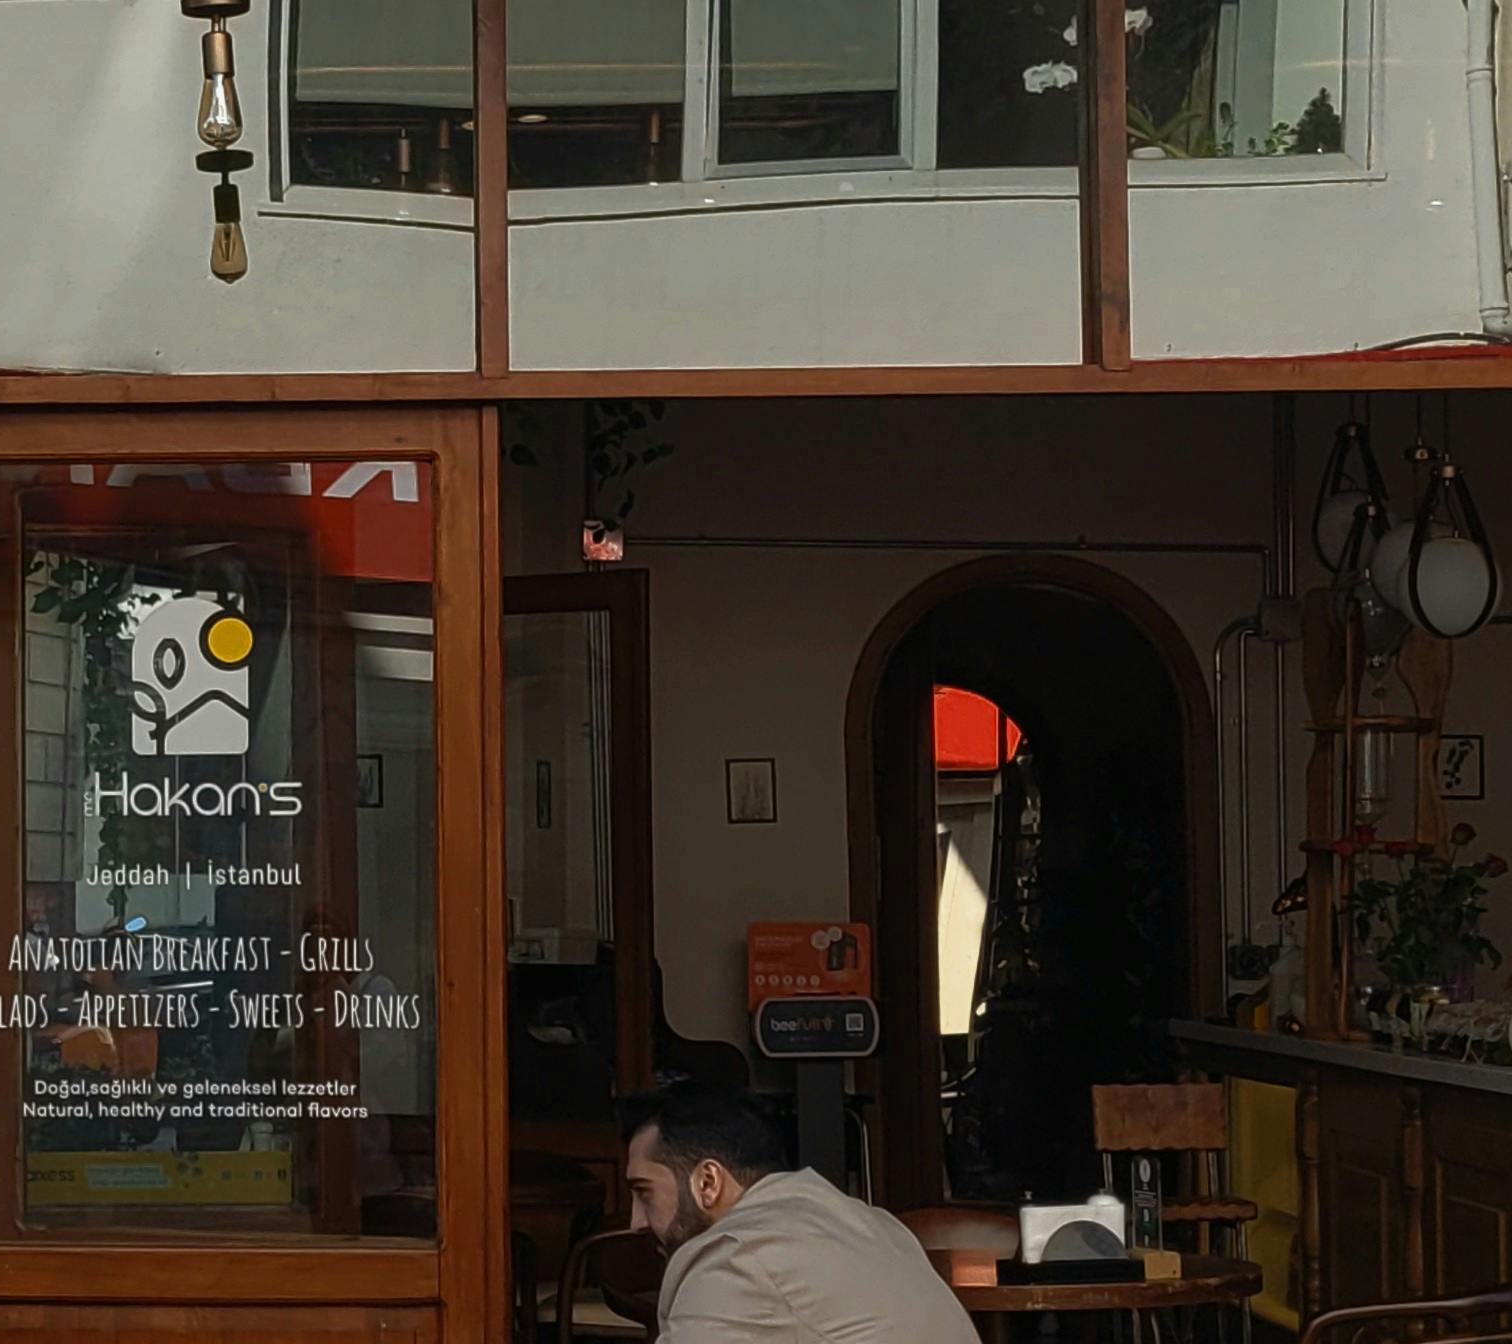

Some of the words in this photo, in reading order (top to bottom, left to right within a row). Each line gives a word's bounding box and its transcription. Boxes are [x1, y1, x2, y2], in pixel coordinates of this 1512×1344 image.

[94, 771, 303, 816] Hakan's
[86, 863, 169, 886] Jeddah
[8, 934, 143, 972] ANATOLIAN
[152, 933, 271, 972] BREAKFAST
[300, 932, 374, 972] GRILLS
[78, 990, 199, 1029] APPETIZERS
[229, 989, 304, 1029] SWEETS
[334, 990, 421, 1030] DRINKS
[157, 1083, 178, 1095] ve
[183, 1079, 277, 1099] geleneksel
[282, 1079, 357, 1096] lezzetler
[23, 1102, 93, 1120] Natural,
[99, 1102, 165, 1122] healthy
[170, 1102, 204, 1118] and
[209, 1102, 302, 1118] traditional
[308, 1102, 369, 1118] flavors
